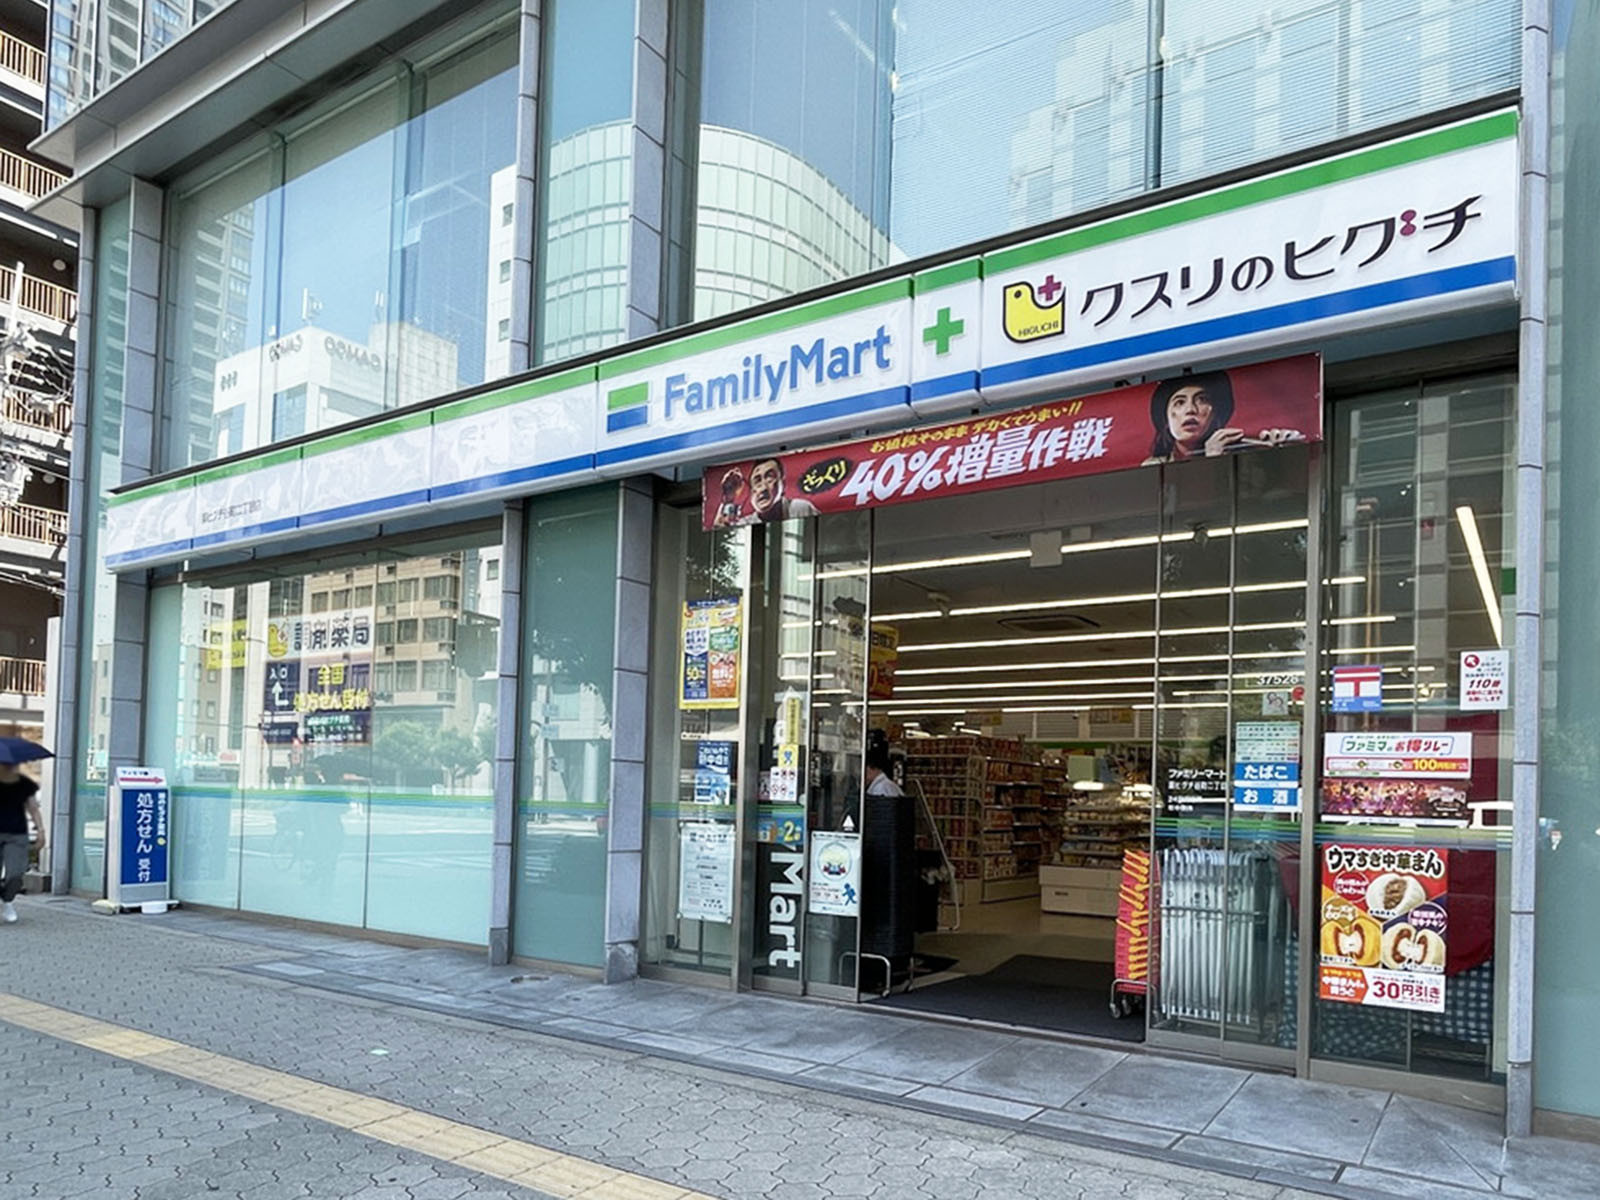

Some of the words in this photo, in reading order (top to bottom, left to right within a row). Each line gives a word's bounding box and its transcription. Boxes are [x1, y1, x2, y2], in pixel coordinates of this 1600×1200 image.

[1079, 195, 1482, 326] クスリのヒグチ
[1018, 320, 1060, 336] HIGUCHI
[664, 325, 891, 418] FamilyMart
[839, 416, 1114, 506] 40%増量作戦
[1168, 768, 1227, 779] ファミリーマート
[1244, 765, 1288, 779] たばこ
[136, 793, 153, 854] 処方せん
[138, 858, 151, 882] 受付
[1328, 847, 1443, 876] ウマすぎ中華まん
[1373, 980, 1440, 1000] 30円引き
